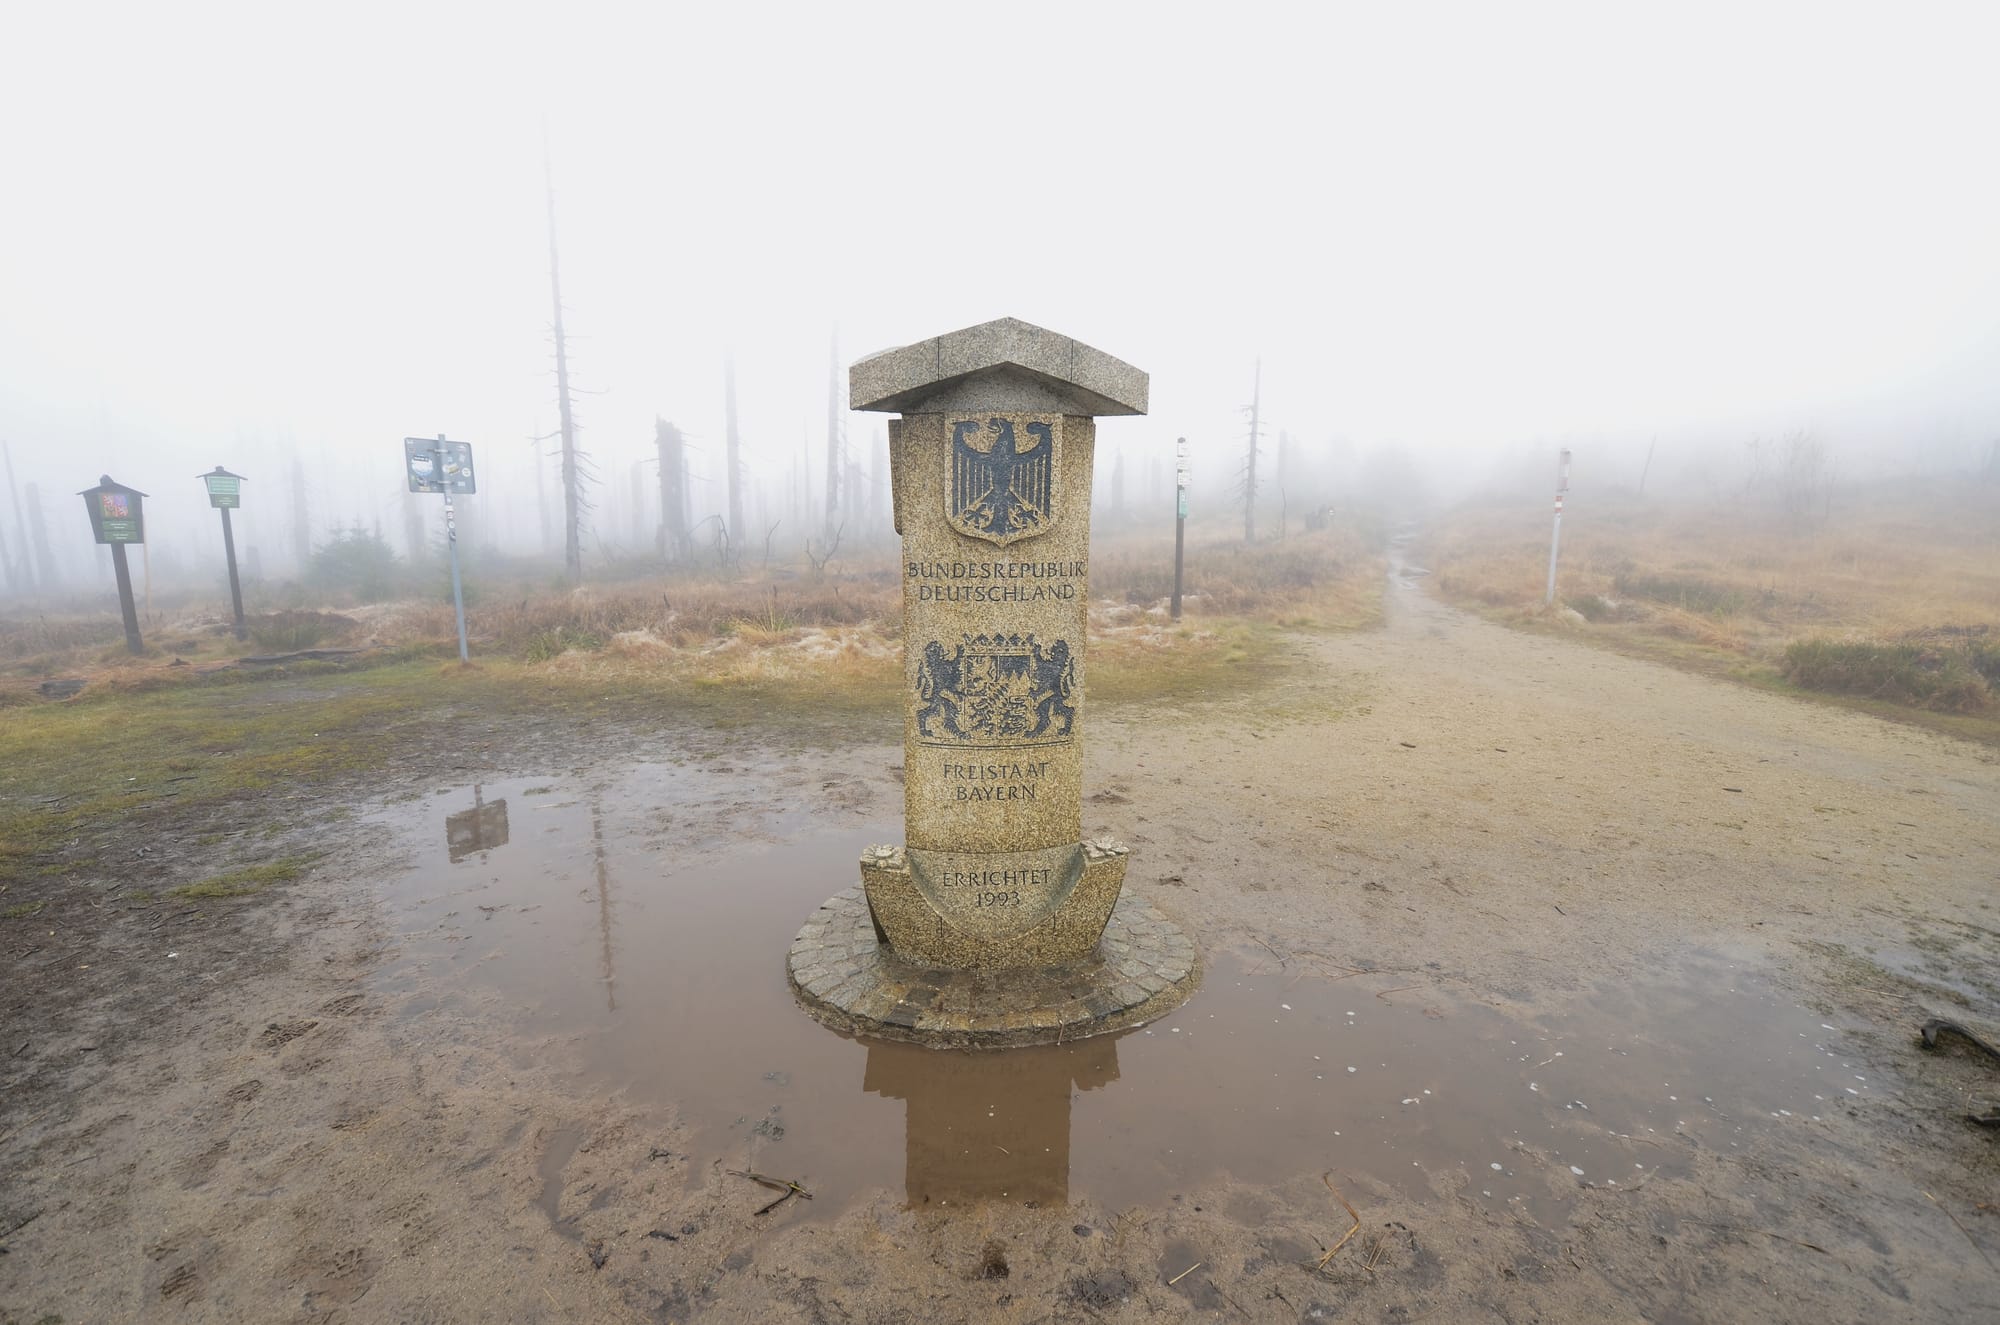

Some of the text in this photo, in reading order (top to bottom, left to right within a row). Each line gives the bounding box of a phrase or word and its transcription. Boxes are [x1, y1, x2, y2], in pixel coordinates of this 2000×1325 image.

[908, 561, 1086, 579] BUNDESREPUBLIK
[919, 584, 1075, 602] DEUTSCHLAND
[943, 762, 1050, 780] FREISTAAT
[956, 784, 1036, 801] BAYERN
[943, 869, 1051, 887] ERRICHTET
[976, 891, 1020, 908] 1993
